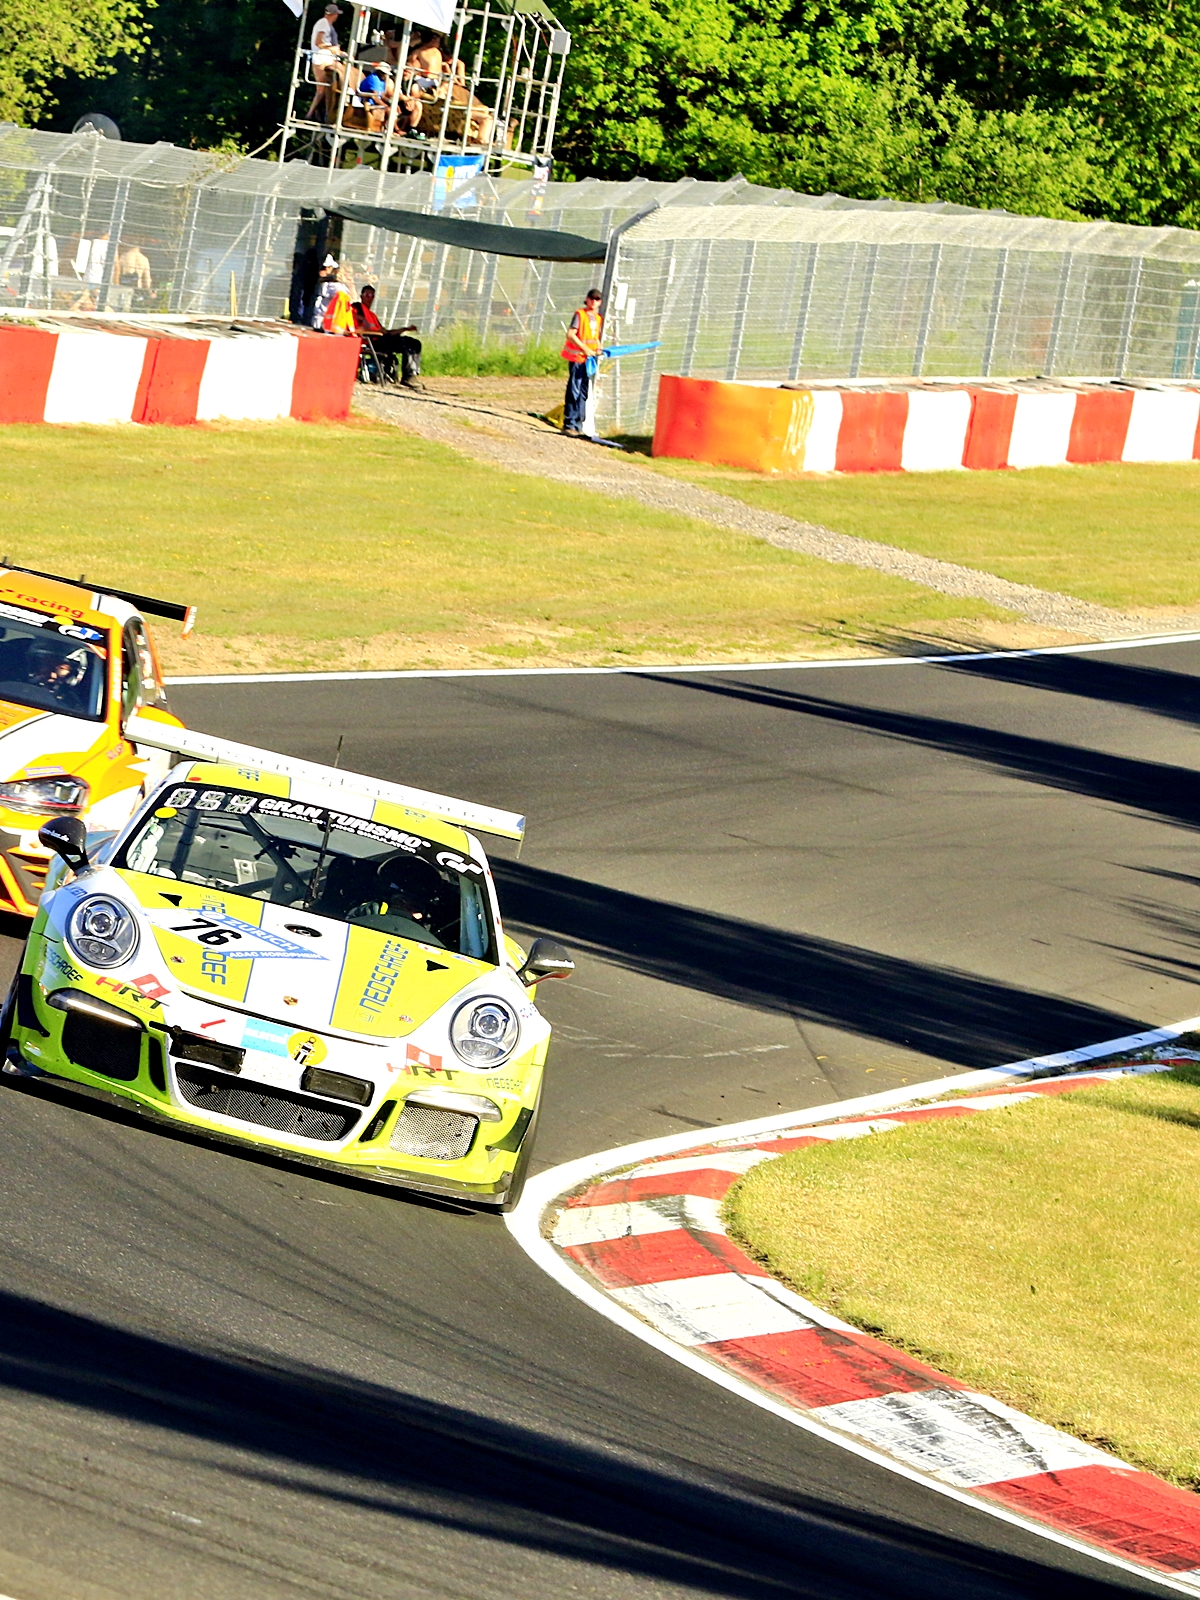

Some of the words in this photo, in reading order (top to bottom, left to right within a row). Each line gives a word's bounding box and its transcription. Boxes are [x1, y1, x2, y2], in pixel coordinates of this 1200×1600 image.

[16, 592, 85, 620] racing
[258, 798, 324, 819] GRAN
[327, 811, 424, 849] TURISMO
[259, 808, 280, 817] THE
[282, 812, 311, 824] REAL
[356, 829, 417, 854] SIMULATOR
[169, 917, 242, 946] 76
[225, 918, 300, 951] ZURICH
[229, 951, 261, 959] ADAC
[95, 976, 170, 1010] HRT
[386, 1062, 459, 1081] HRT
